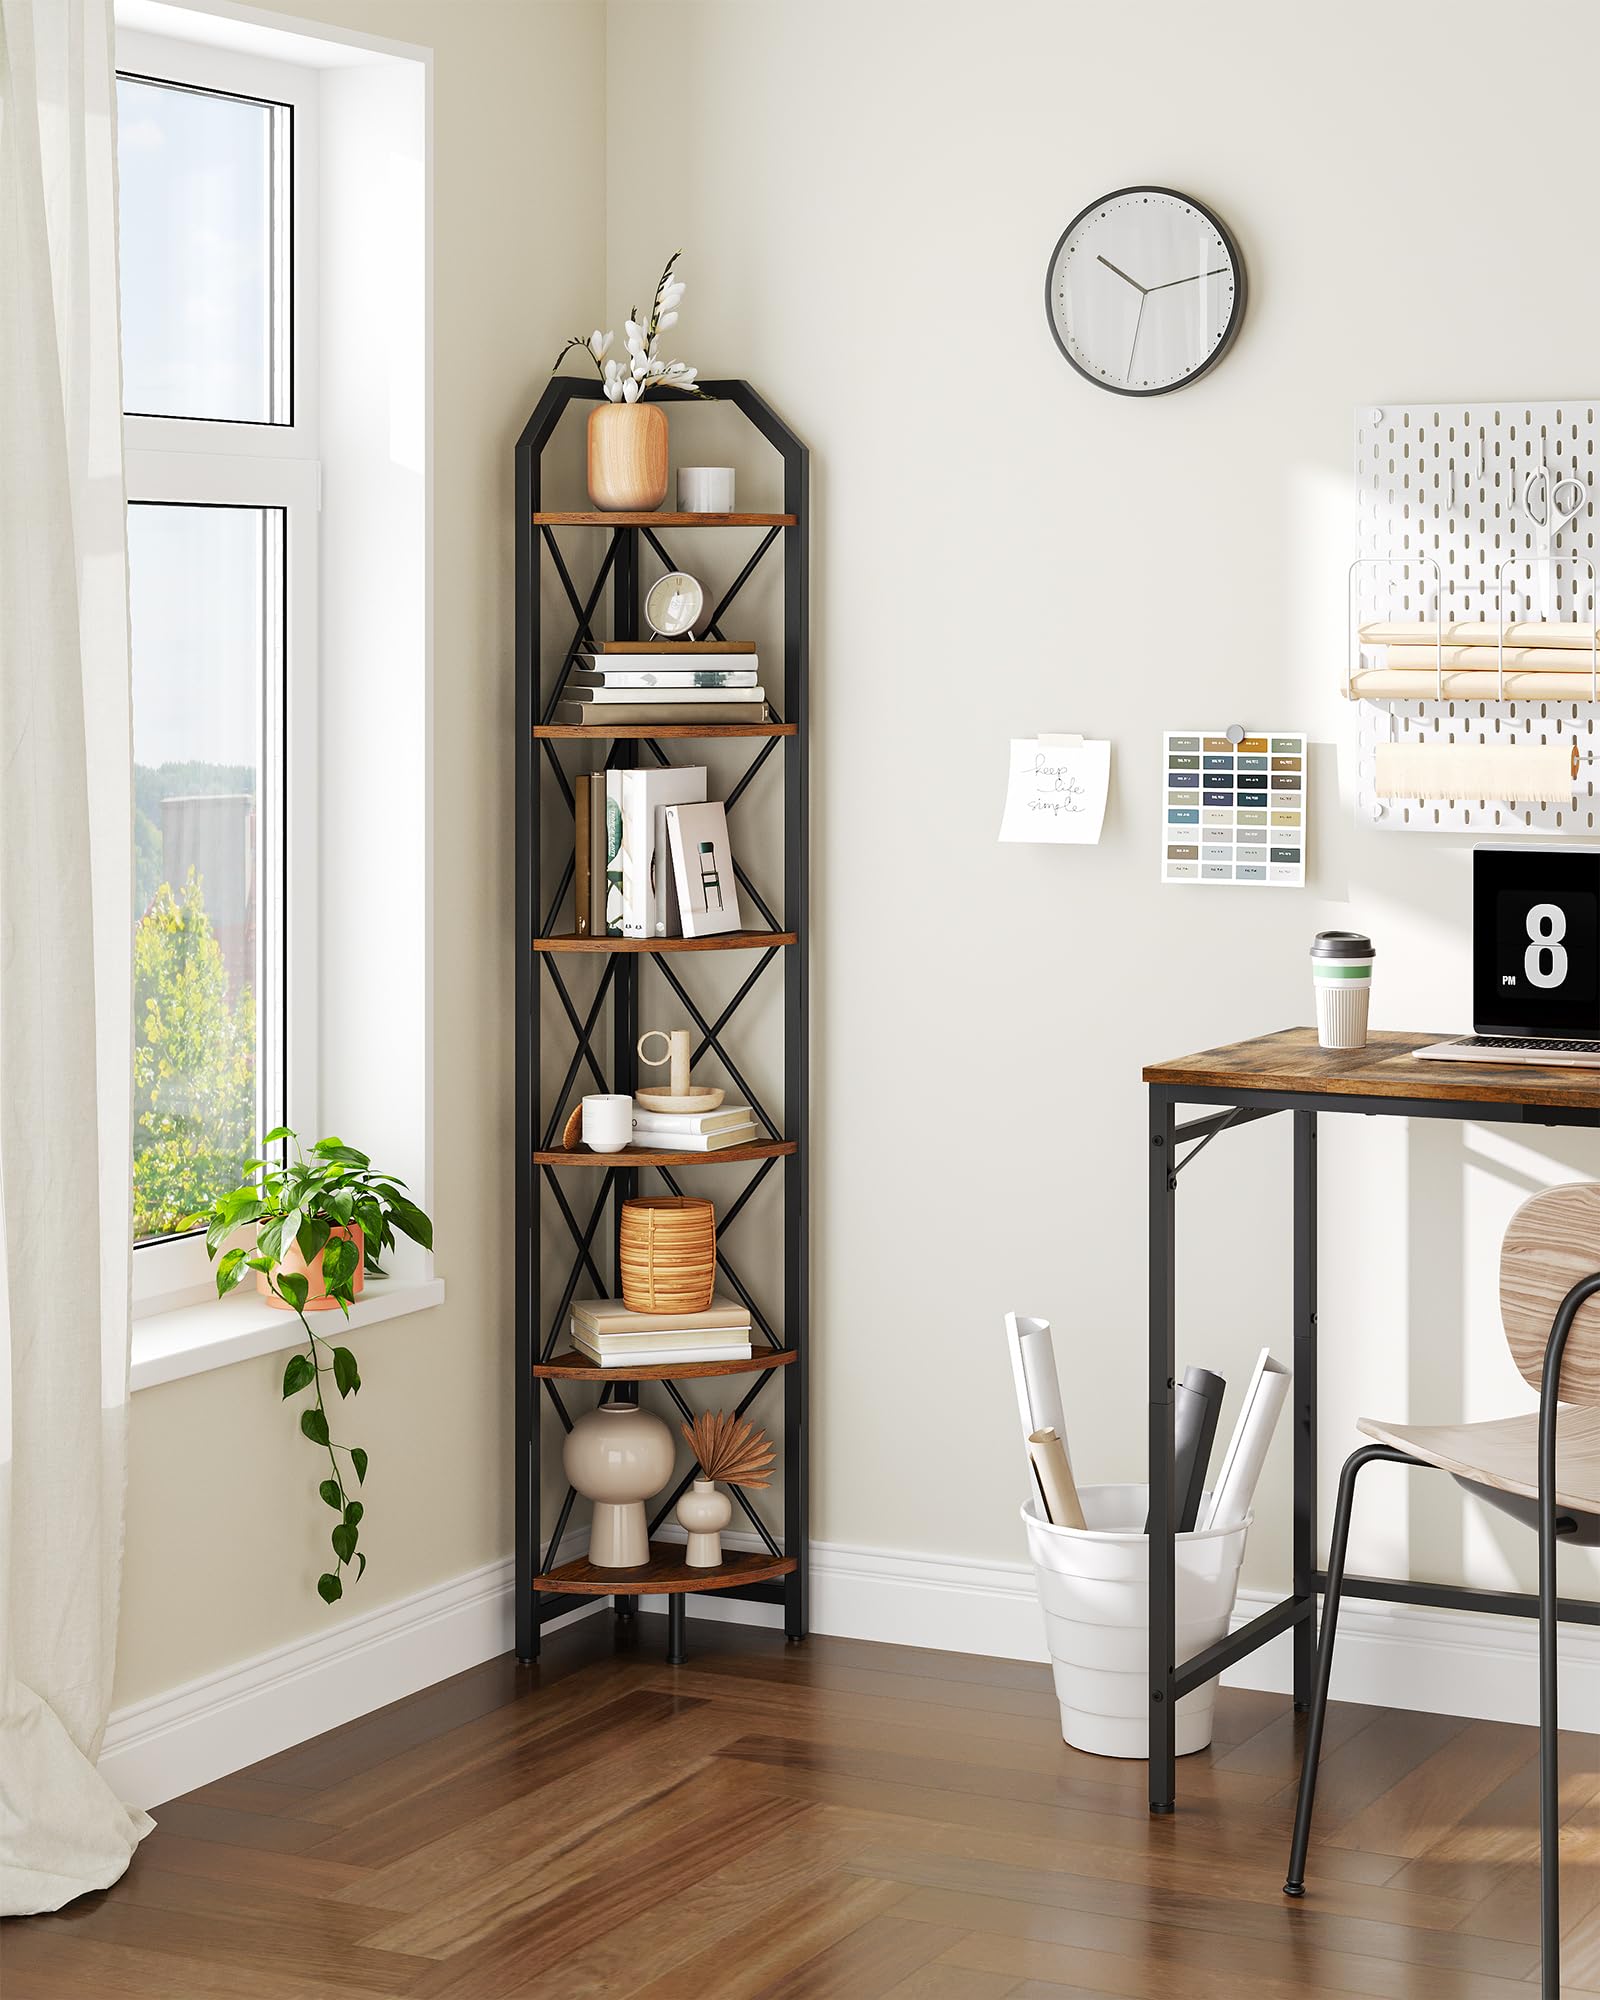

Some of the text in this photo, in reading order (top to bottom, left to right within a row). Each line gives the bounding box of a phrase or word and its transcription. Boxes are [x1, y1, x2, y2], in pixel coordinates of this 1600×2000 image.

[1036, 777, 1085, 796] life
[1027, 796, 1086, 816] simple
[1524, 903, 1568, 989] 8
[1502, 975, 1516, 986] PM
